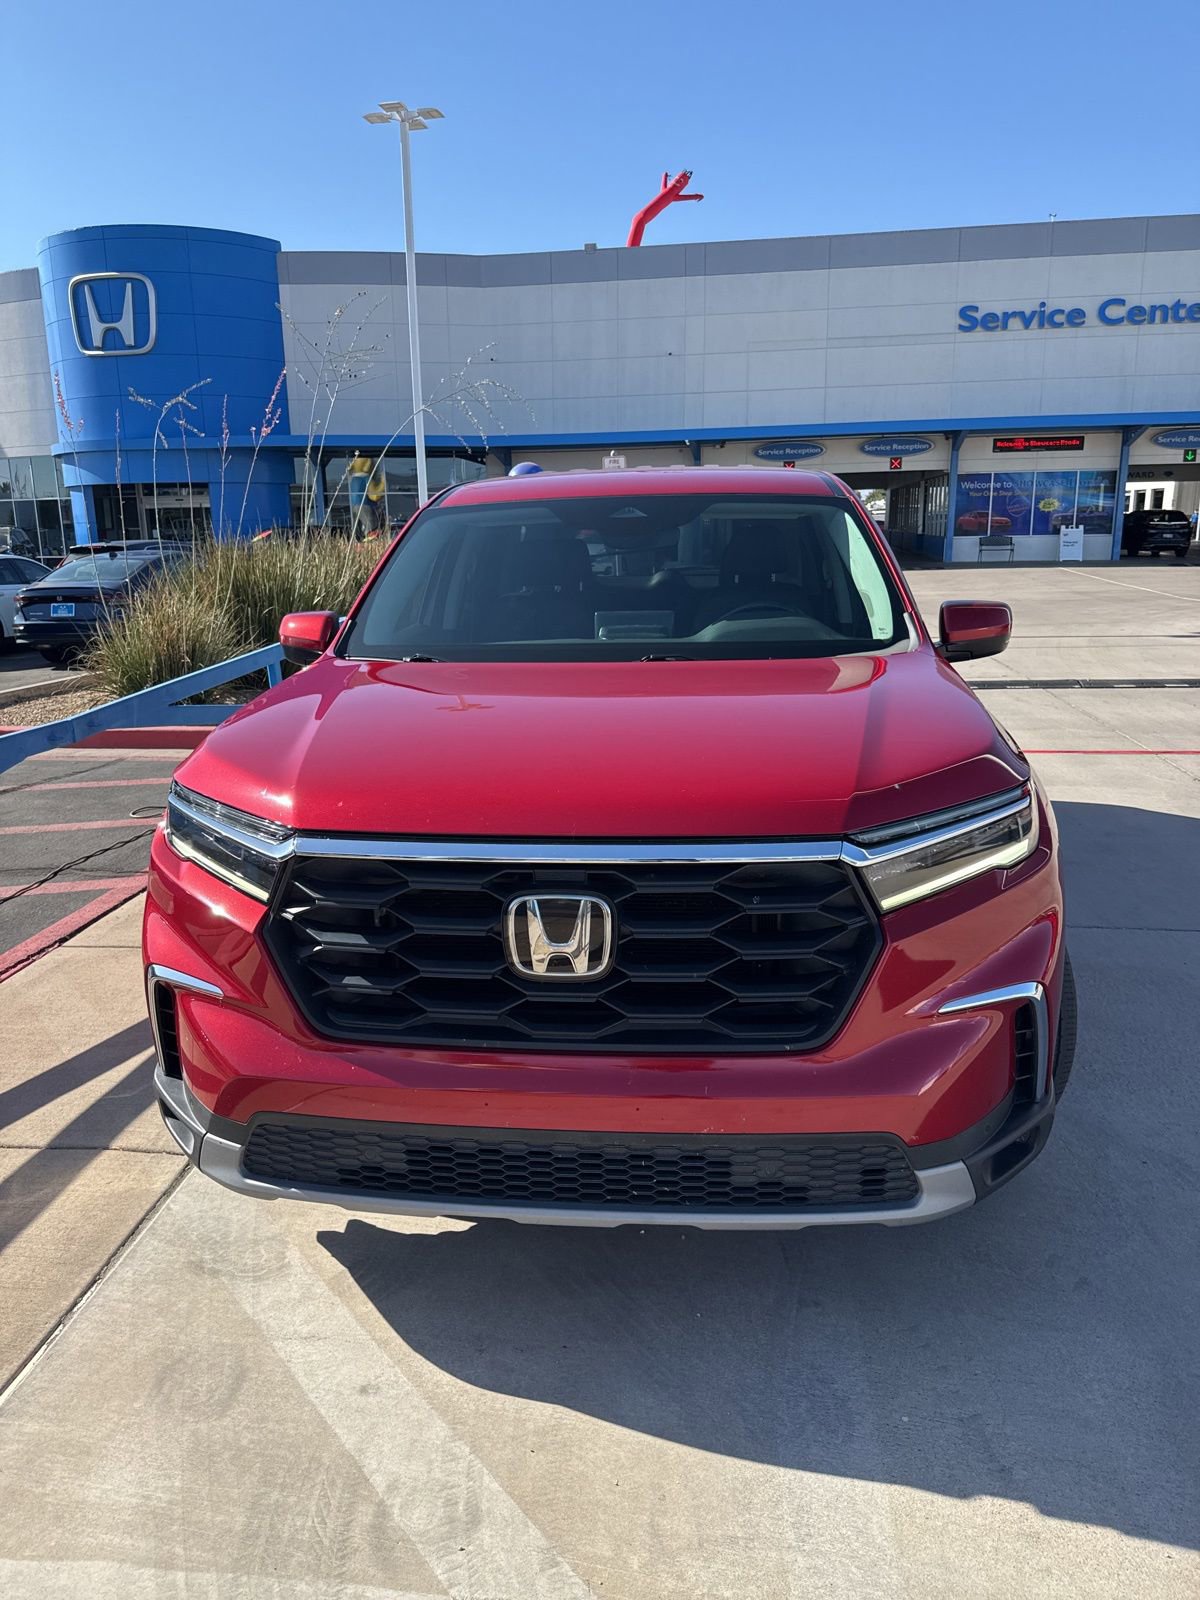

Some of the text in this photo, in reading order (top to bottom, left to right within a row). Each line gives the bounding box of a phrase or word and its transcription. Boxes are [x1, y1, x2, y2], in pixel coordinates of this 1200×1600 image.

[957, 301, 1087, 333] Service
[758, 447, 821, 456] Service Reception
[864, 442, 929, 452] Service Reception
[961, 481, 1002, 489] Welcome
[1003, 481, 1013, 489] to
